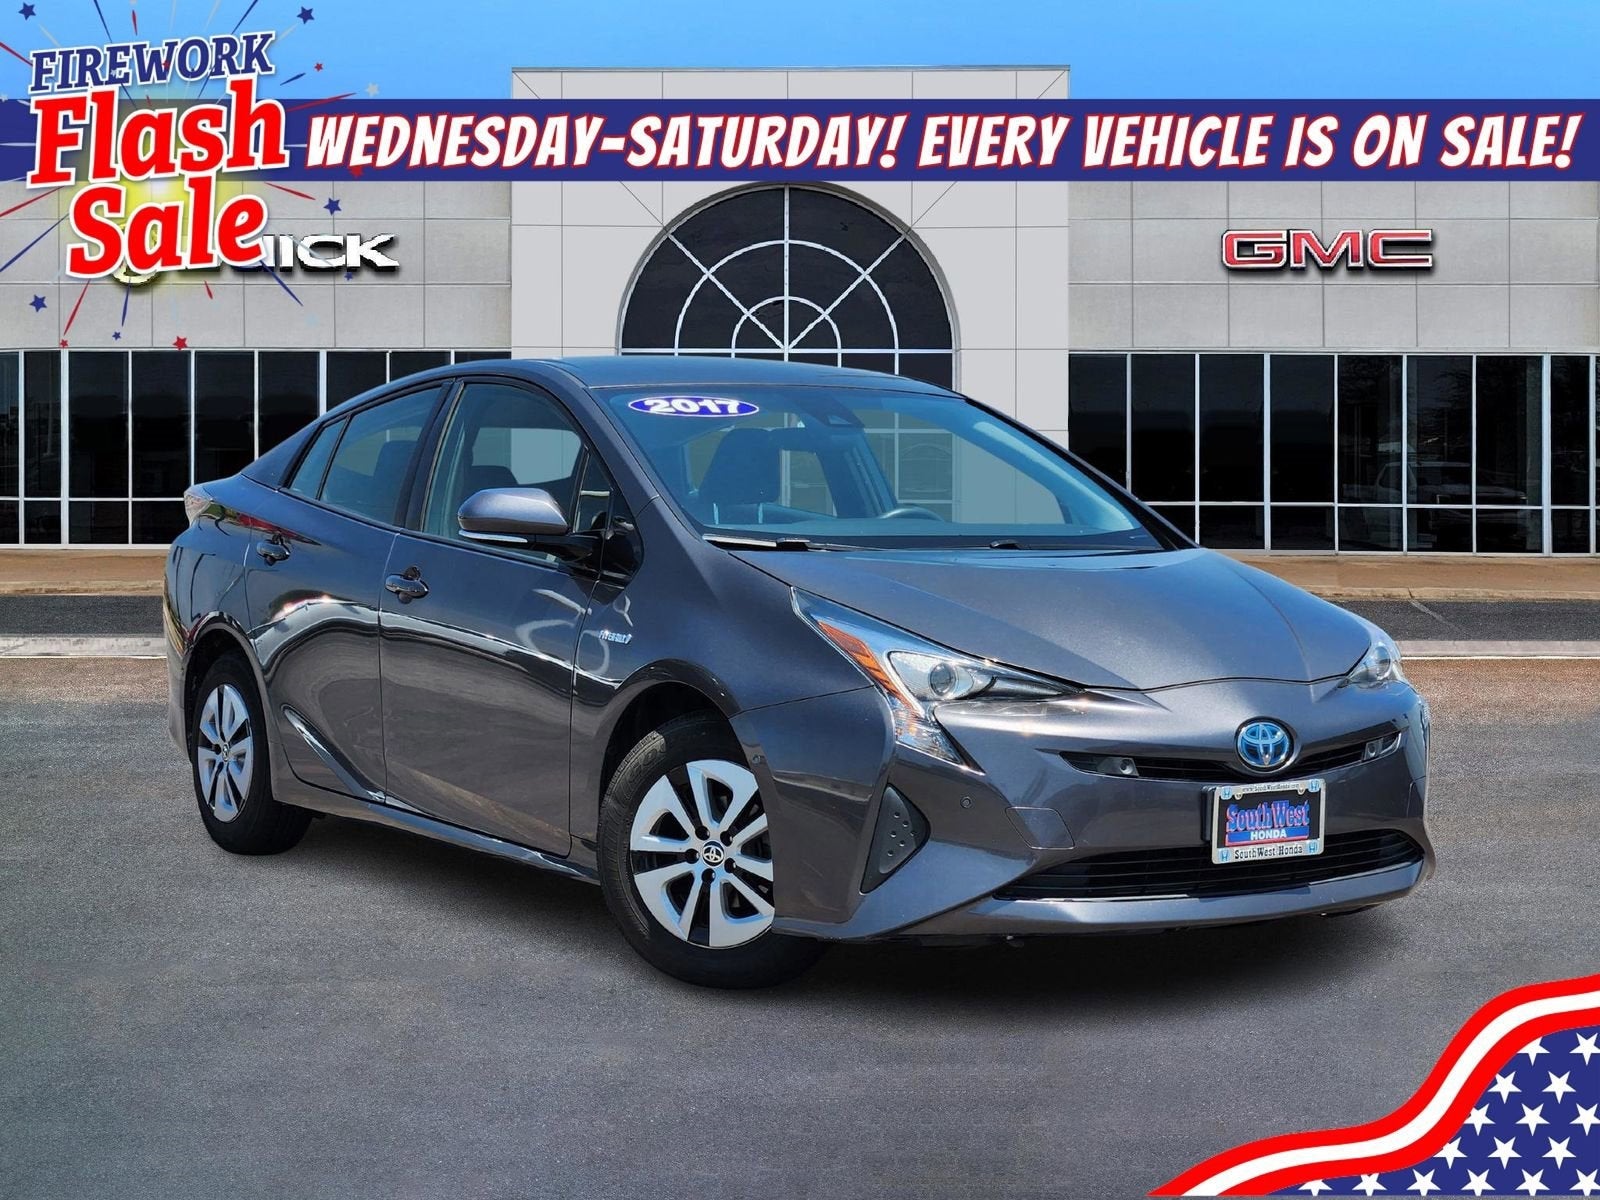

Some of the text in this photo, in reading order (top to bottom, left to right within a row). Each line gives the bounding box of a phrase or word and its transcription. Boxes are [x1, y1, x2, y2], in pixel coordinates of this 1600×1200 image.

[1222, 229, 1433, 268] GMC
[644, 398, 740, 414] 2017
[1250, 829, 1287, 841] HONDA
[1278, 844, 1303, 856] Honda
